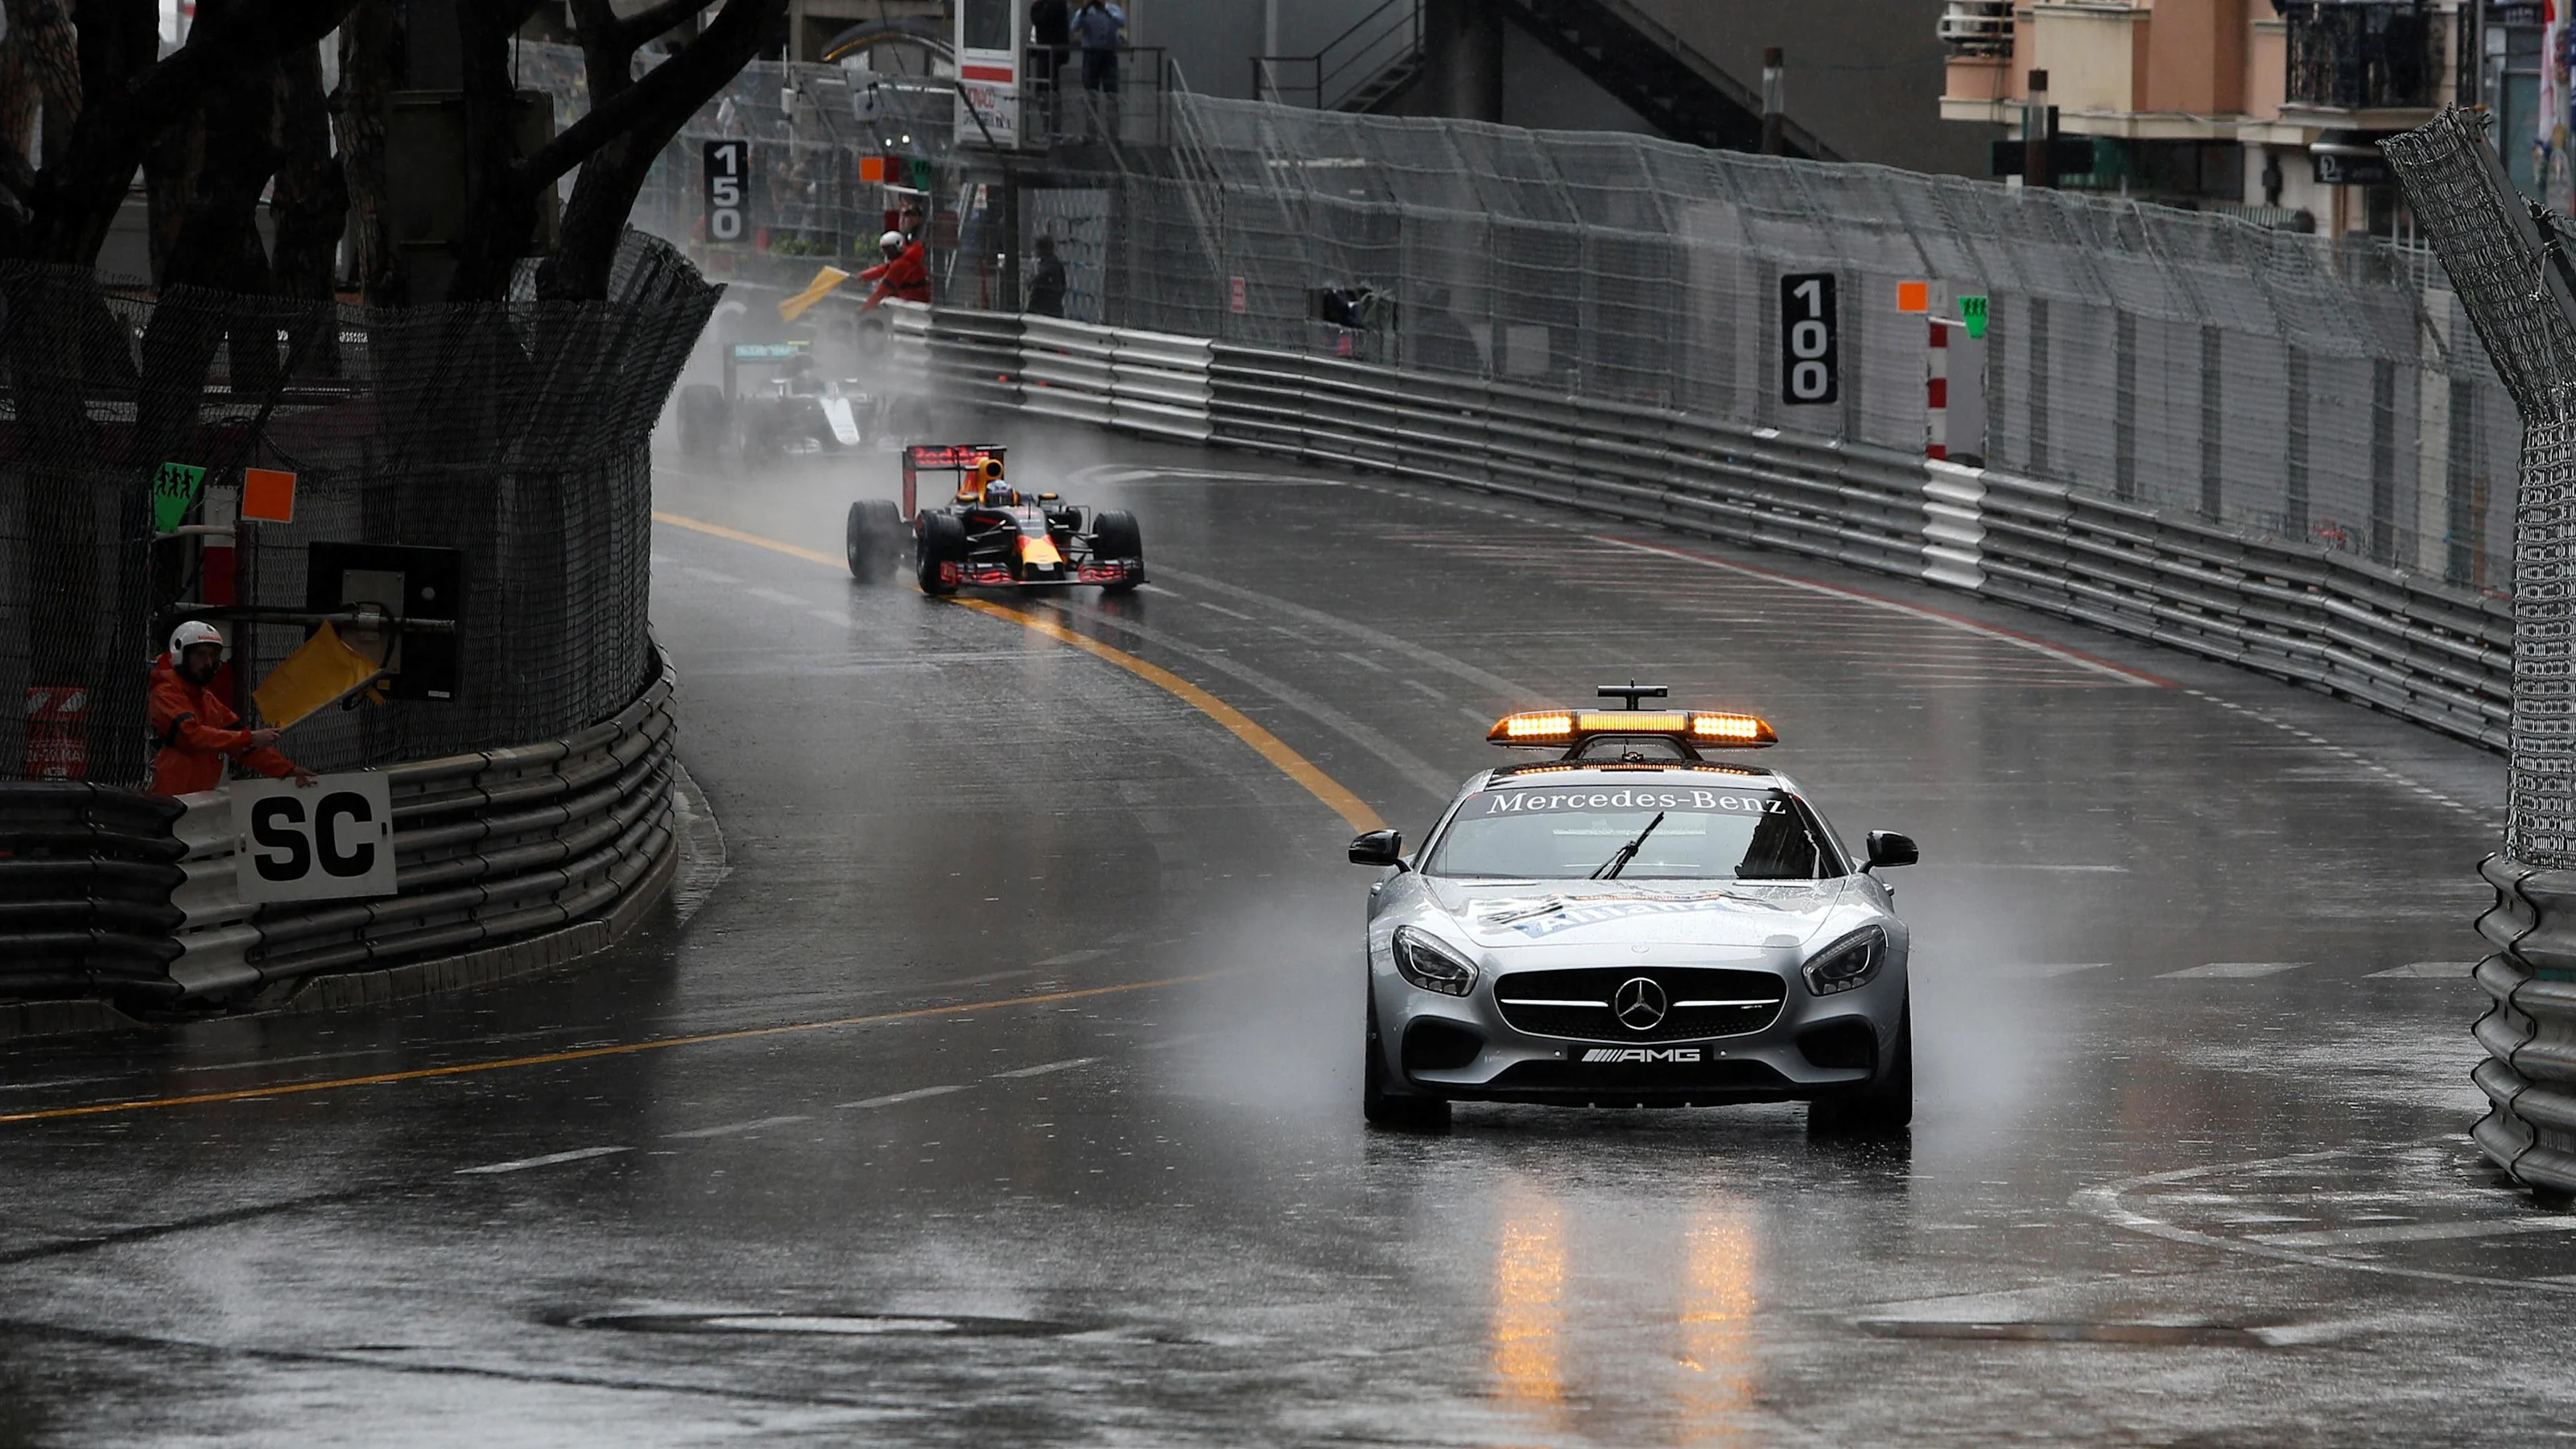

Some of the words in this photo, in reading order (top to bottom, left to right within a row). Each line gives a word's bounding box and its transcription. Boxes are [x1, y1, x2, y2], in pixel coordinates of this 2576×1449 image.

[713, 145, 741, 240] 150
[1793, 280, 1827, 399] 100
[1486, 790, 1786, 815] Mercedes-Benz
[251, 791, 375, 881] SC
[1540, 901, 1721, 931] Allianz
[1616, 1049, 1700, 1063] AMG
